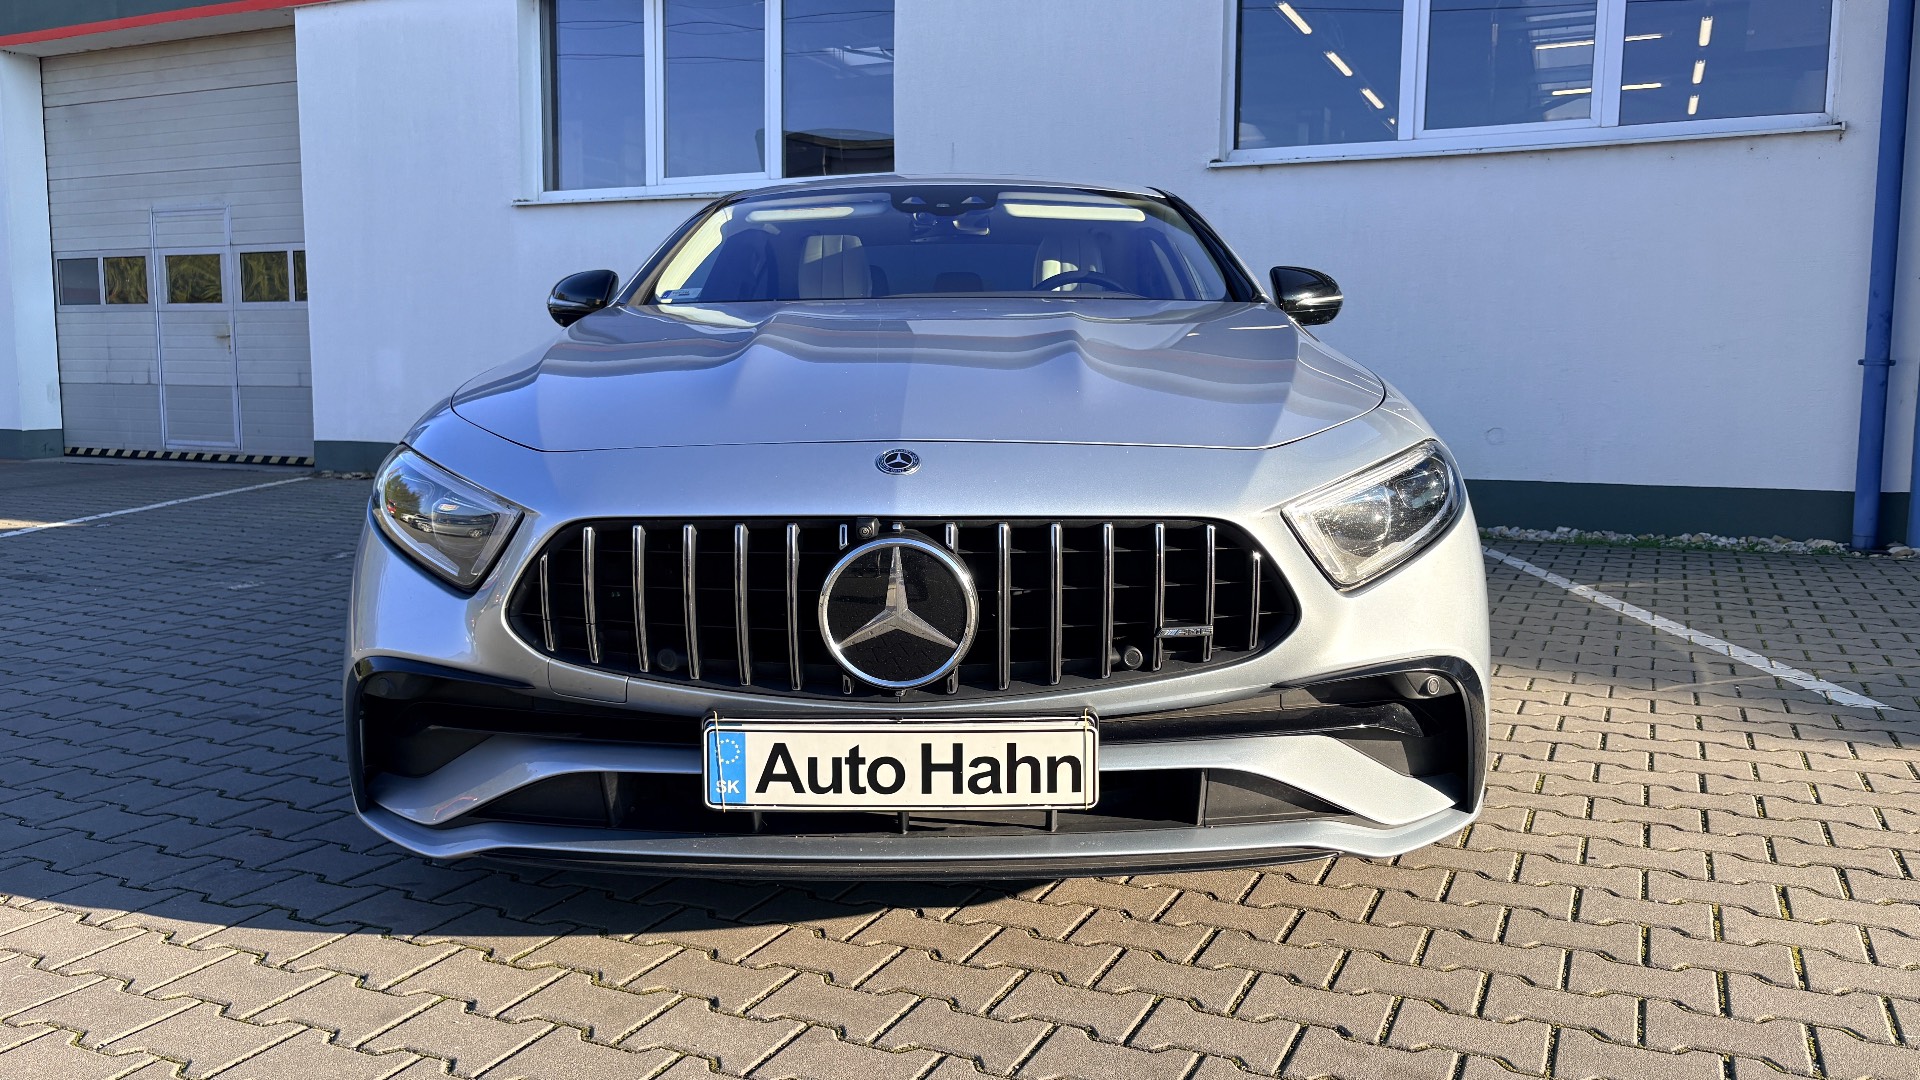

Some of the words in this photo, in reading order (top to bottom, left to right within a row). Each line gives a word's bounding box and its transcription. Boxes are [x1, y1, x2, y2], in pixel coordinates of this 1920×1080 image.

[755, 742, 906, 795] Auto
[921, 742, 1082, 794] Hahn
[715, 780, 740, 794] SK
